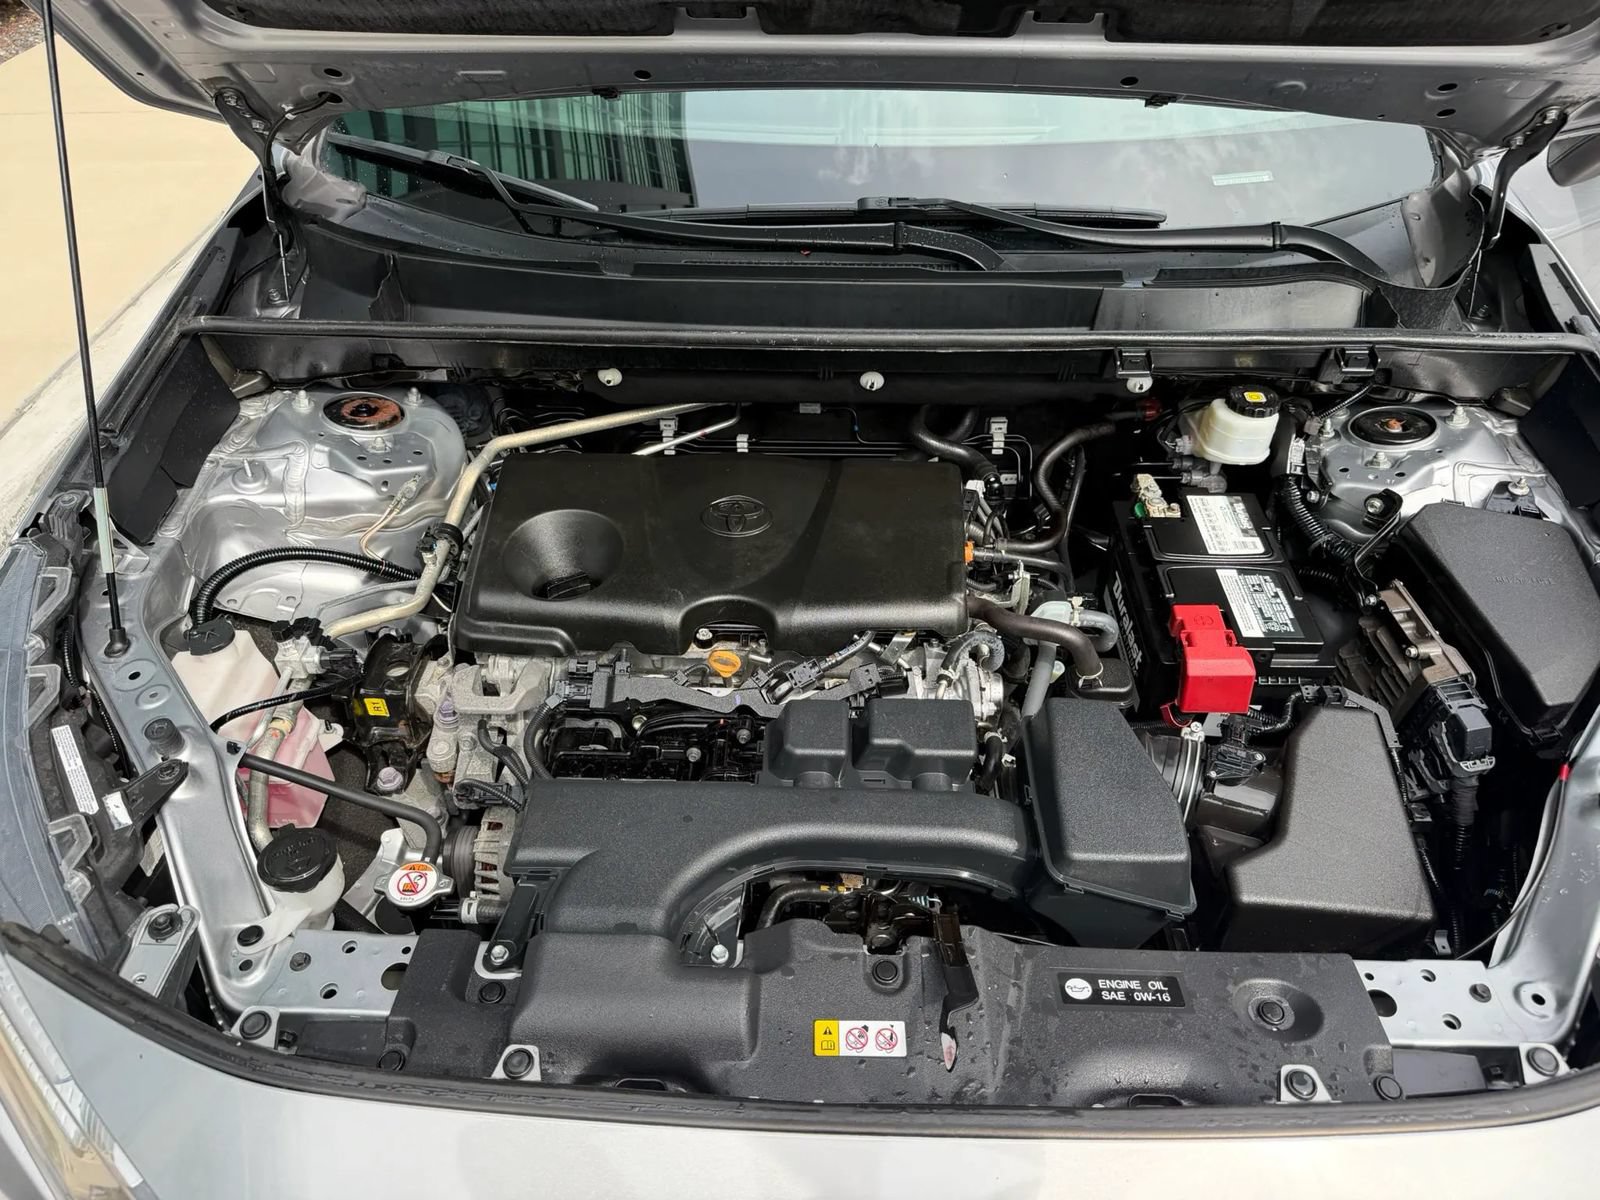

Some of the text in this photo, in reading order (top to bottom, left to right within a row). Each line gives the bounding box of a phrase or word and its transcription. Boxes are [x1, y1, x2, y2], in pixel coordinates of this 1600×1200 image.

[1113, 571, 1142, 670] Duralast
[1098, 979, 1168, 991] ENGINE OIL
[1101, 991, 1171, 1002] SAE 0W-16
